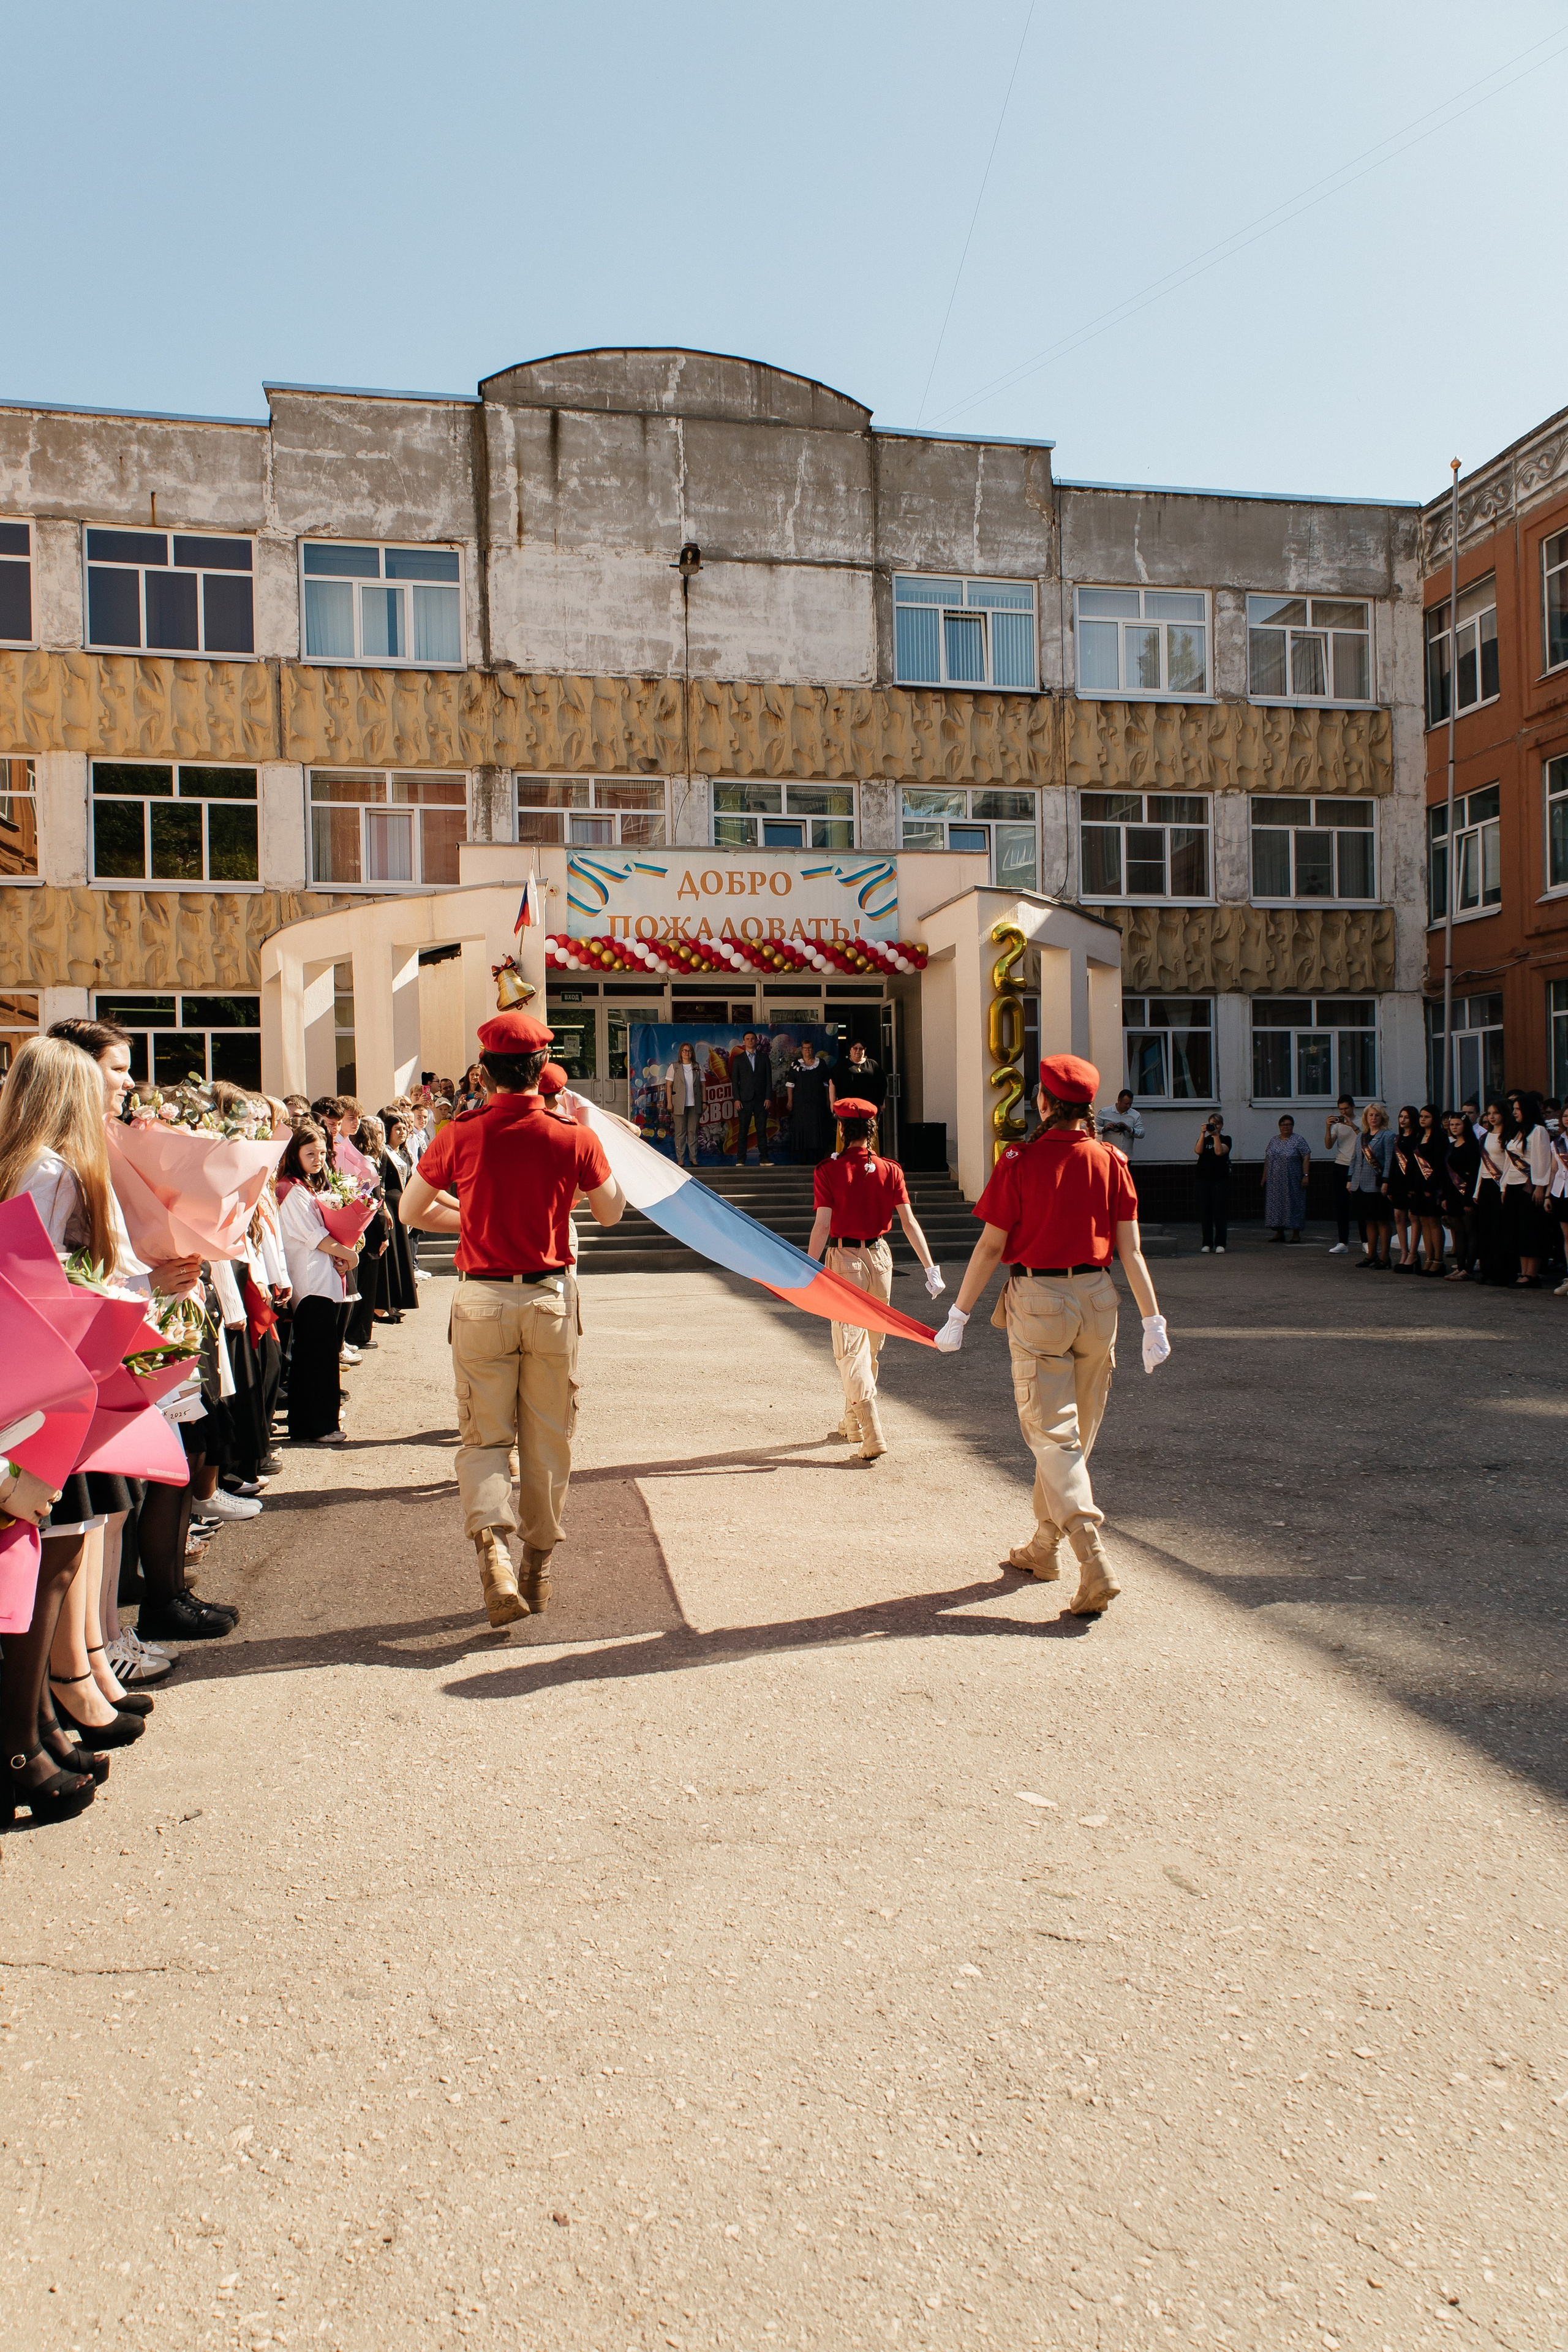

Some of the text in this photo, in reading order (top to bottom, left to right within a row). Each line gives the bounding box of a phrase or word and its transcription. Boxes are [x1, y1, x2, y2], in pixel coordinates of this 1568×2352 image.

[677, 870, 792, 901] ДОБРО
[606, 914, 861, 941] ПОЖАЛОВАТЬ!
[170, 1409, 190, 1419] 2025
